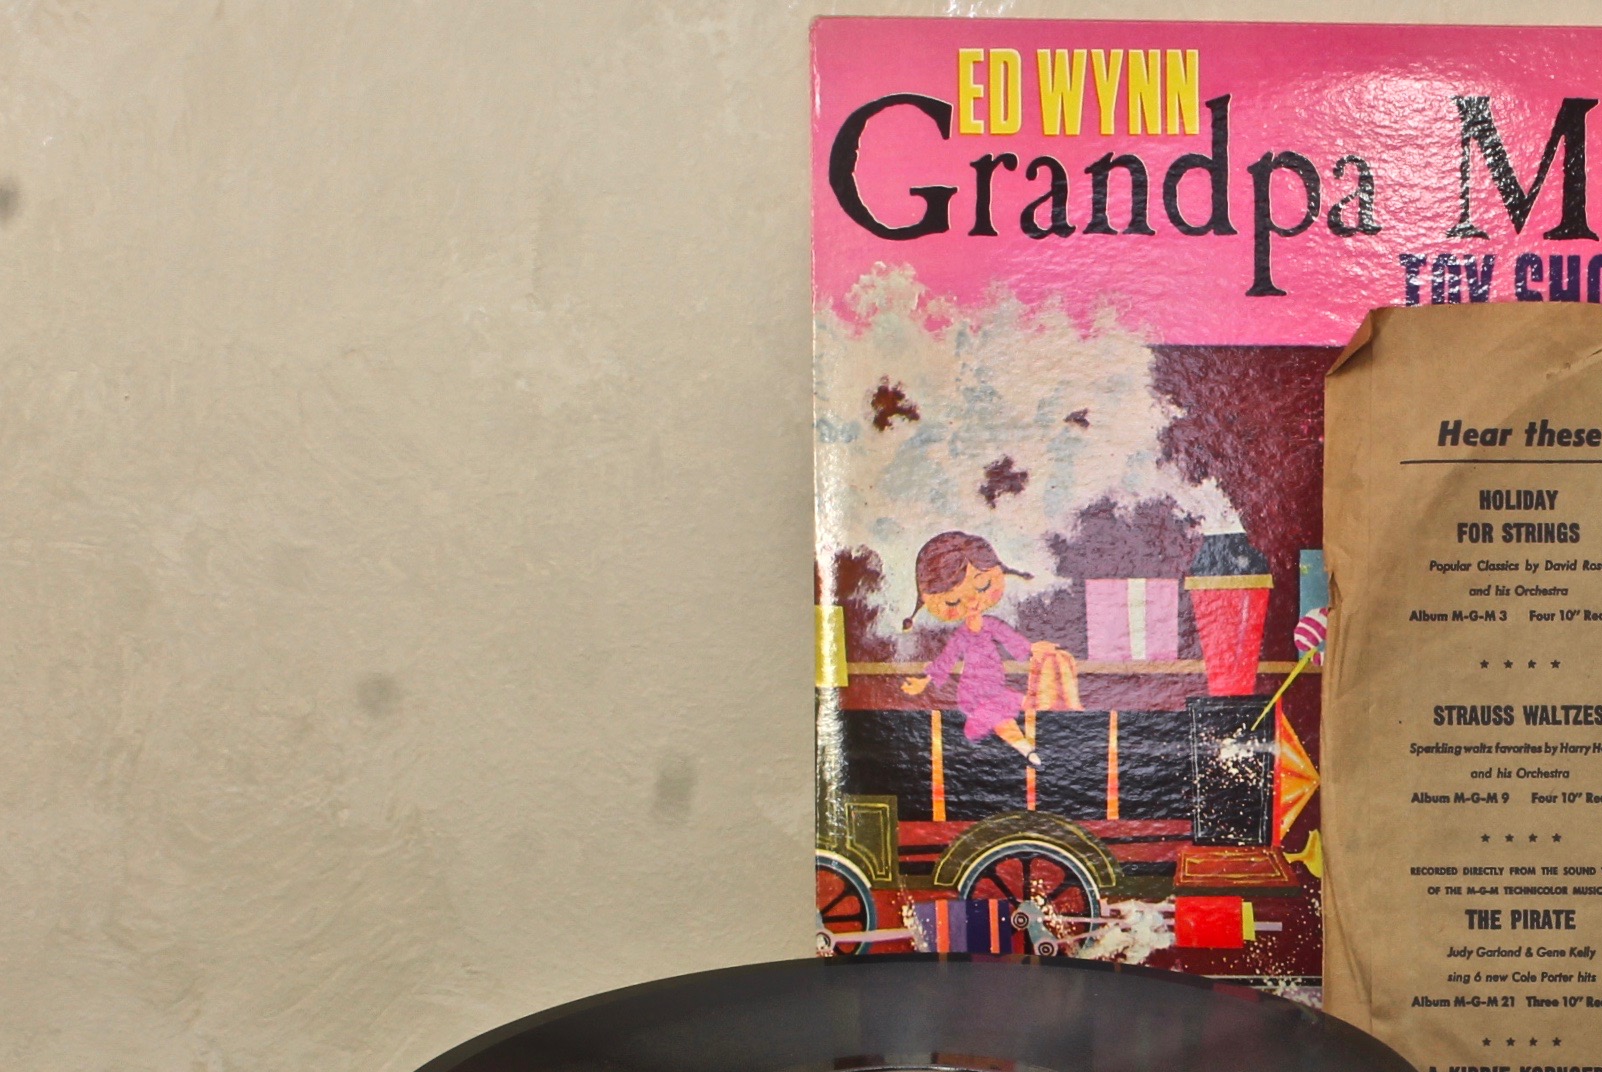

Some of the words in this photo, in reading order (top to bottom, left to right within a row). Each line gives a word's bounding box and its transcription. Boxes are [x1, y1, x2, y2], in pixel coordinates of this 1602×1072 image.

[957, 48, 1022, 136] ED
[1036, 49, 1199, 136] WYNN
[828, 92, 1379, 297] Grandpa
[1398, 253, 1497, 307] TOY
[1437, 419, 1514, 448] Hear
[1524, 418, 1602, 448] these
[1479, 489, 1559, 511] HOLIDAY
[1456, 522, 1494, 544] FOR
[1501, 522, 1581, 544] STRINGS
[1428, 559, 1473, 575] Popular
[1476, 559, 1520, 572] Classics
[1524, 558, 1540, 575] by
[1544, 558, 1578, 572] David
[1468, 584, 1492, 597] and
[1494, 584, 1511, 597] his
[1514, 584, 1569, 597] Orchestra
[1408, 609, 1449, 623] Album
[1451, 609, 1497, 622] M-G-M
[1498, 609, 1508, 622] 3
[1528, 609, 1556, 622] Four
[1433, 704, 1515, 727] STRAUSS
[1464, 908, 1502, 931] THE
[1510, 908, 1577, 930] PIRATE
